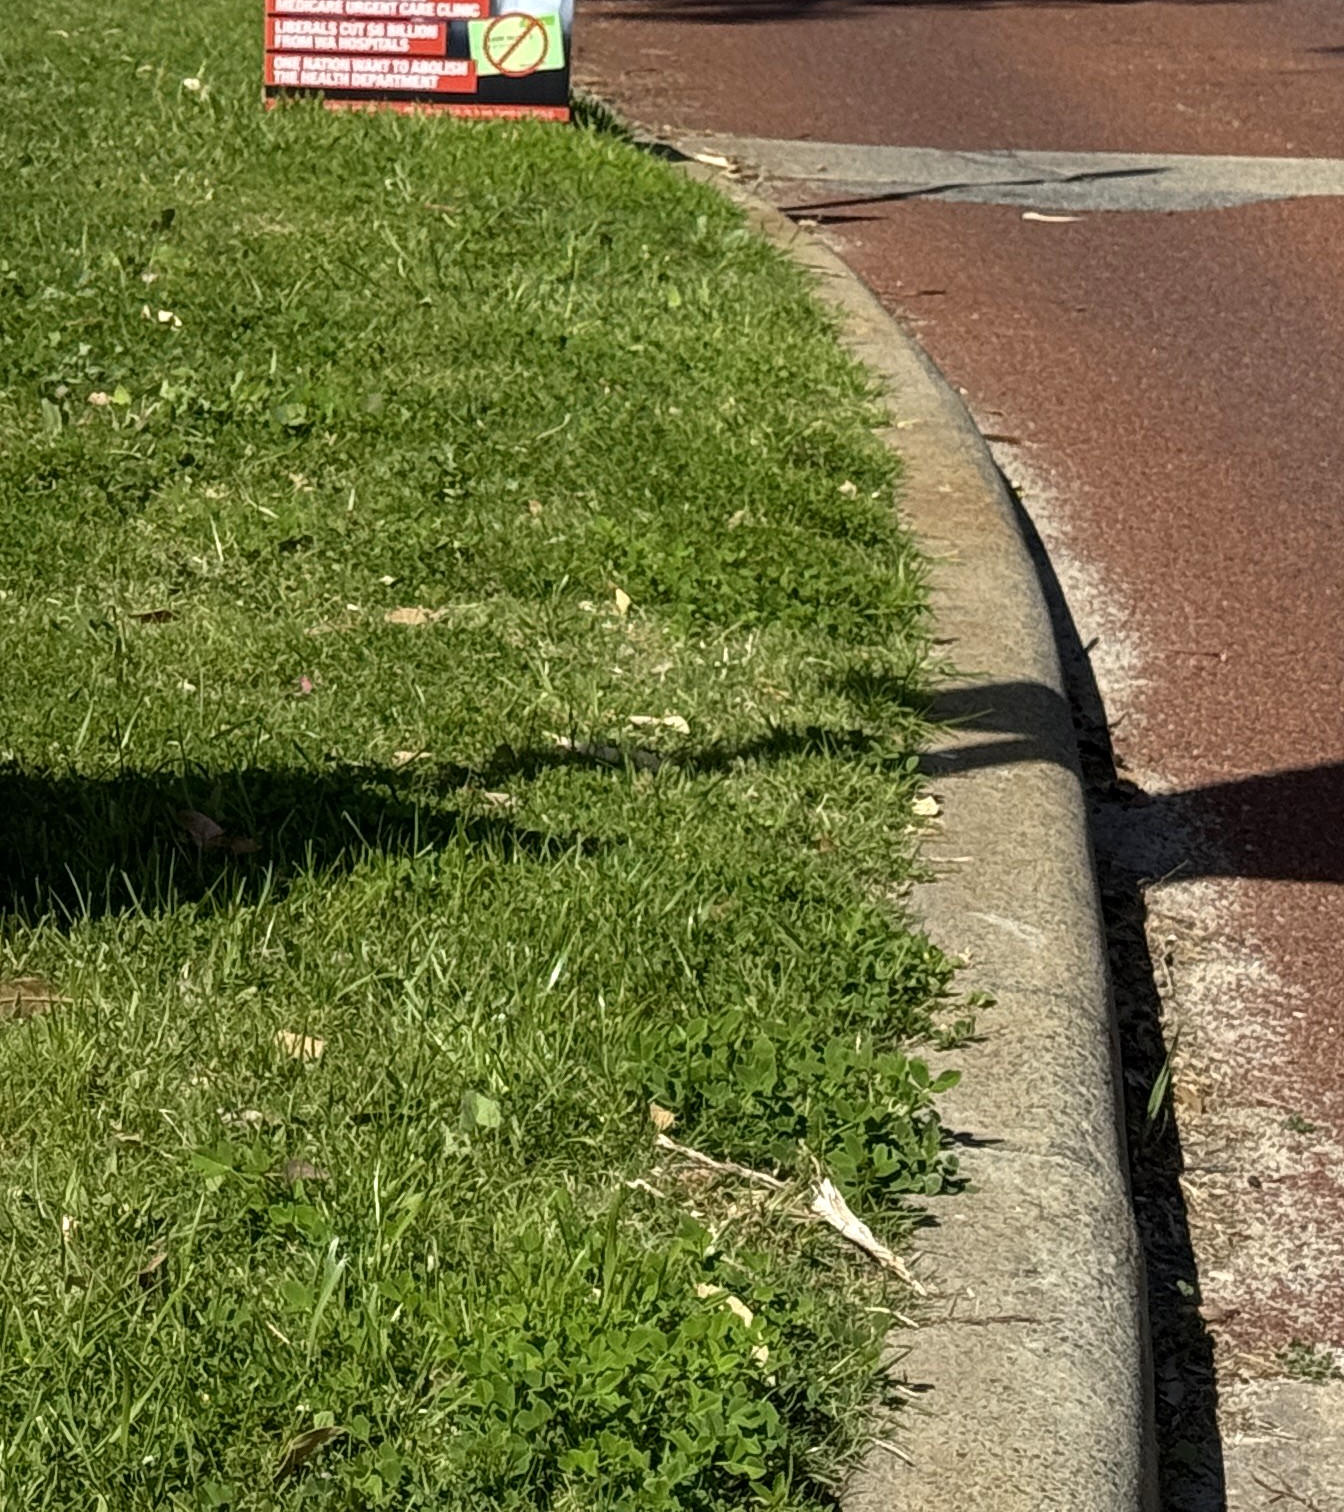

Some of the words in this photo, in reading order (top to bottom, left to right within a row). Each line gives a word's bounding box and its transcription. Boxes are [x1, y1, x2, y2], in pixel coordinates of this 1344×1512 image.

[276, 0, 343, 13] MEDICARE
[346, 1, 398, 15] URGENT
[399, 2, 435, 17] CARE
[437, 3, 481, 17] CLINIC
[275, 20, 337, 35] LIBERALS
[275, 35, 313, 48] FROM
[339, 38, 410, 52] HOSPITALS
[274, 57, 300, 70] ONE
[303, 58, 350, 71] NATION
[352, 59, 391, 72] WANT
[392, 60, 410, 74] TO
[411, 61, 468, 76] ABOLISH
[274, 71, 298, 84] THE
[301, 72, 350, 86] HEALTH
[351, 74, 439, 88] DEPARTMENT
